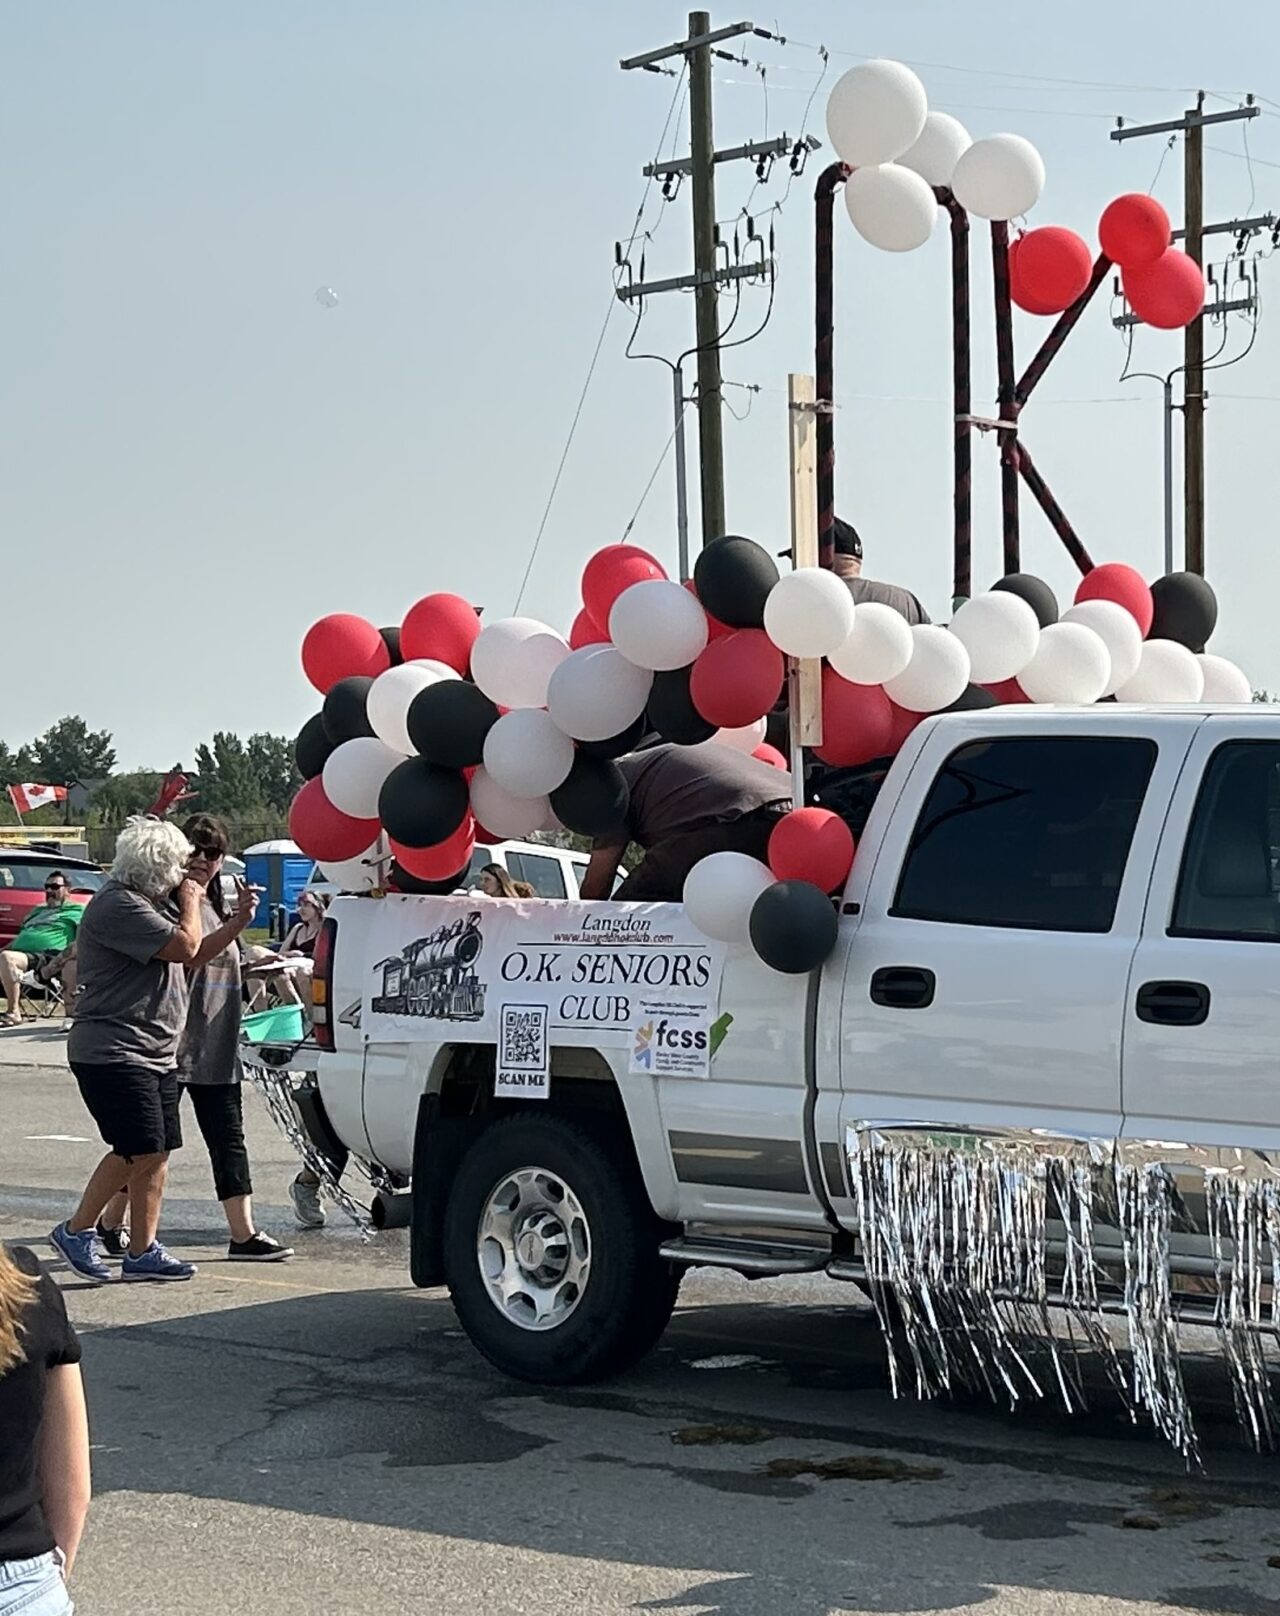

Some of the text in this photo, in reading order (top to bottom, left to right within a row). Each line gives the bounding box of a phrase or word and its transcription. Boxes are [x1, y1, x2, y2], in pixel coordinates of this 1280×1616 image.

[580, 913, 652, 933] Langdon
[500, 952, 712, 988] O.K. SENIORS
[559, 995, 631, 1022] CLUB
[656, 1019, 707, 1050] fcss
[498, 1073, 545, 1087] SCAN ME
